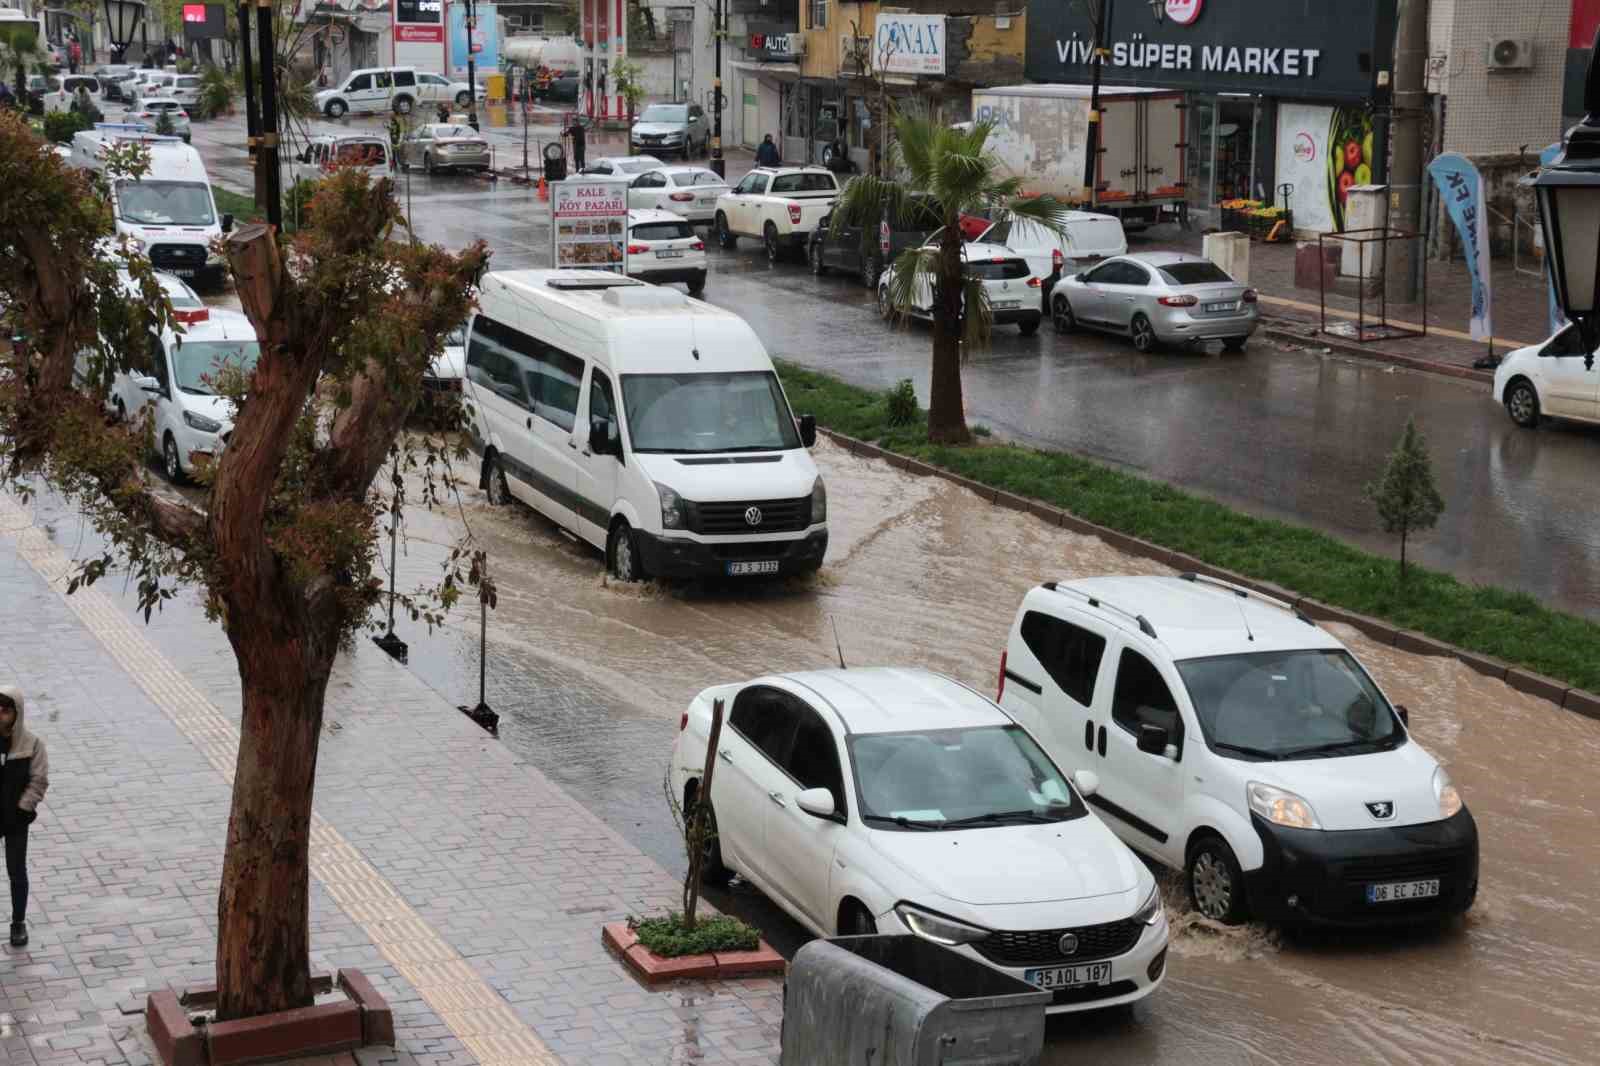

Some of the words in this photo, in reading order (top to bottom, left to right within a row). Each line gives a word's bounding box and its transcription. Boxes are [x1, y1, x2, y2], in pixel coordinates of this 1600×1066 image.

[1113, 34, 1192, 70] SÜPER
[1201, 45, 1320, 77] MARKET
[575, 187, 607, 198] KALE
[559, 199, 582, 211] KÖY
[585, 200, 625, 211] PAZARI
[1376, 885, 1388, 900] 06
[1394, 883, 1407, 898] EC
[1412, 880, 1438, 897] 2678
[1036, 971, 1053, 987] 35
[1056, 966, 1080, 985] AOL
[1086, 963, 1109, 982] 187
